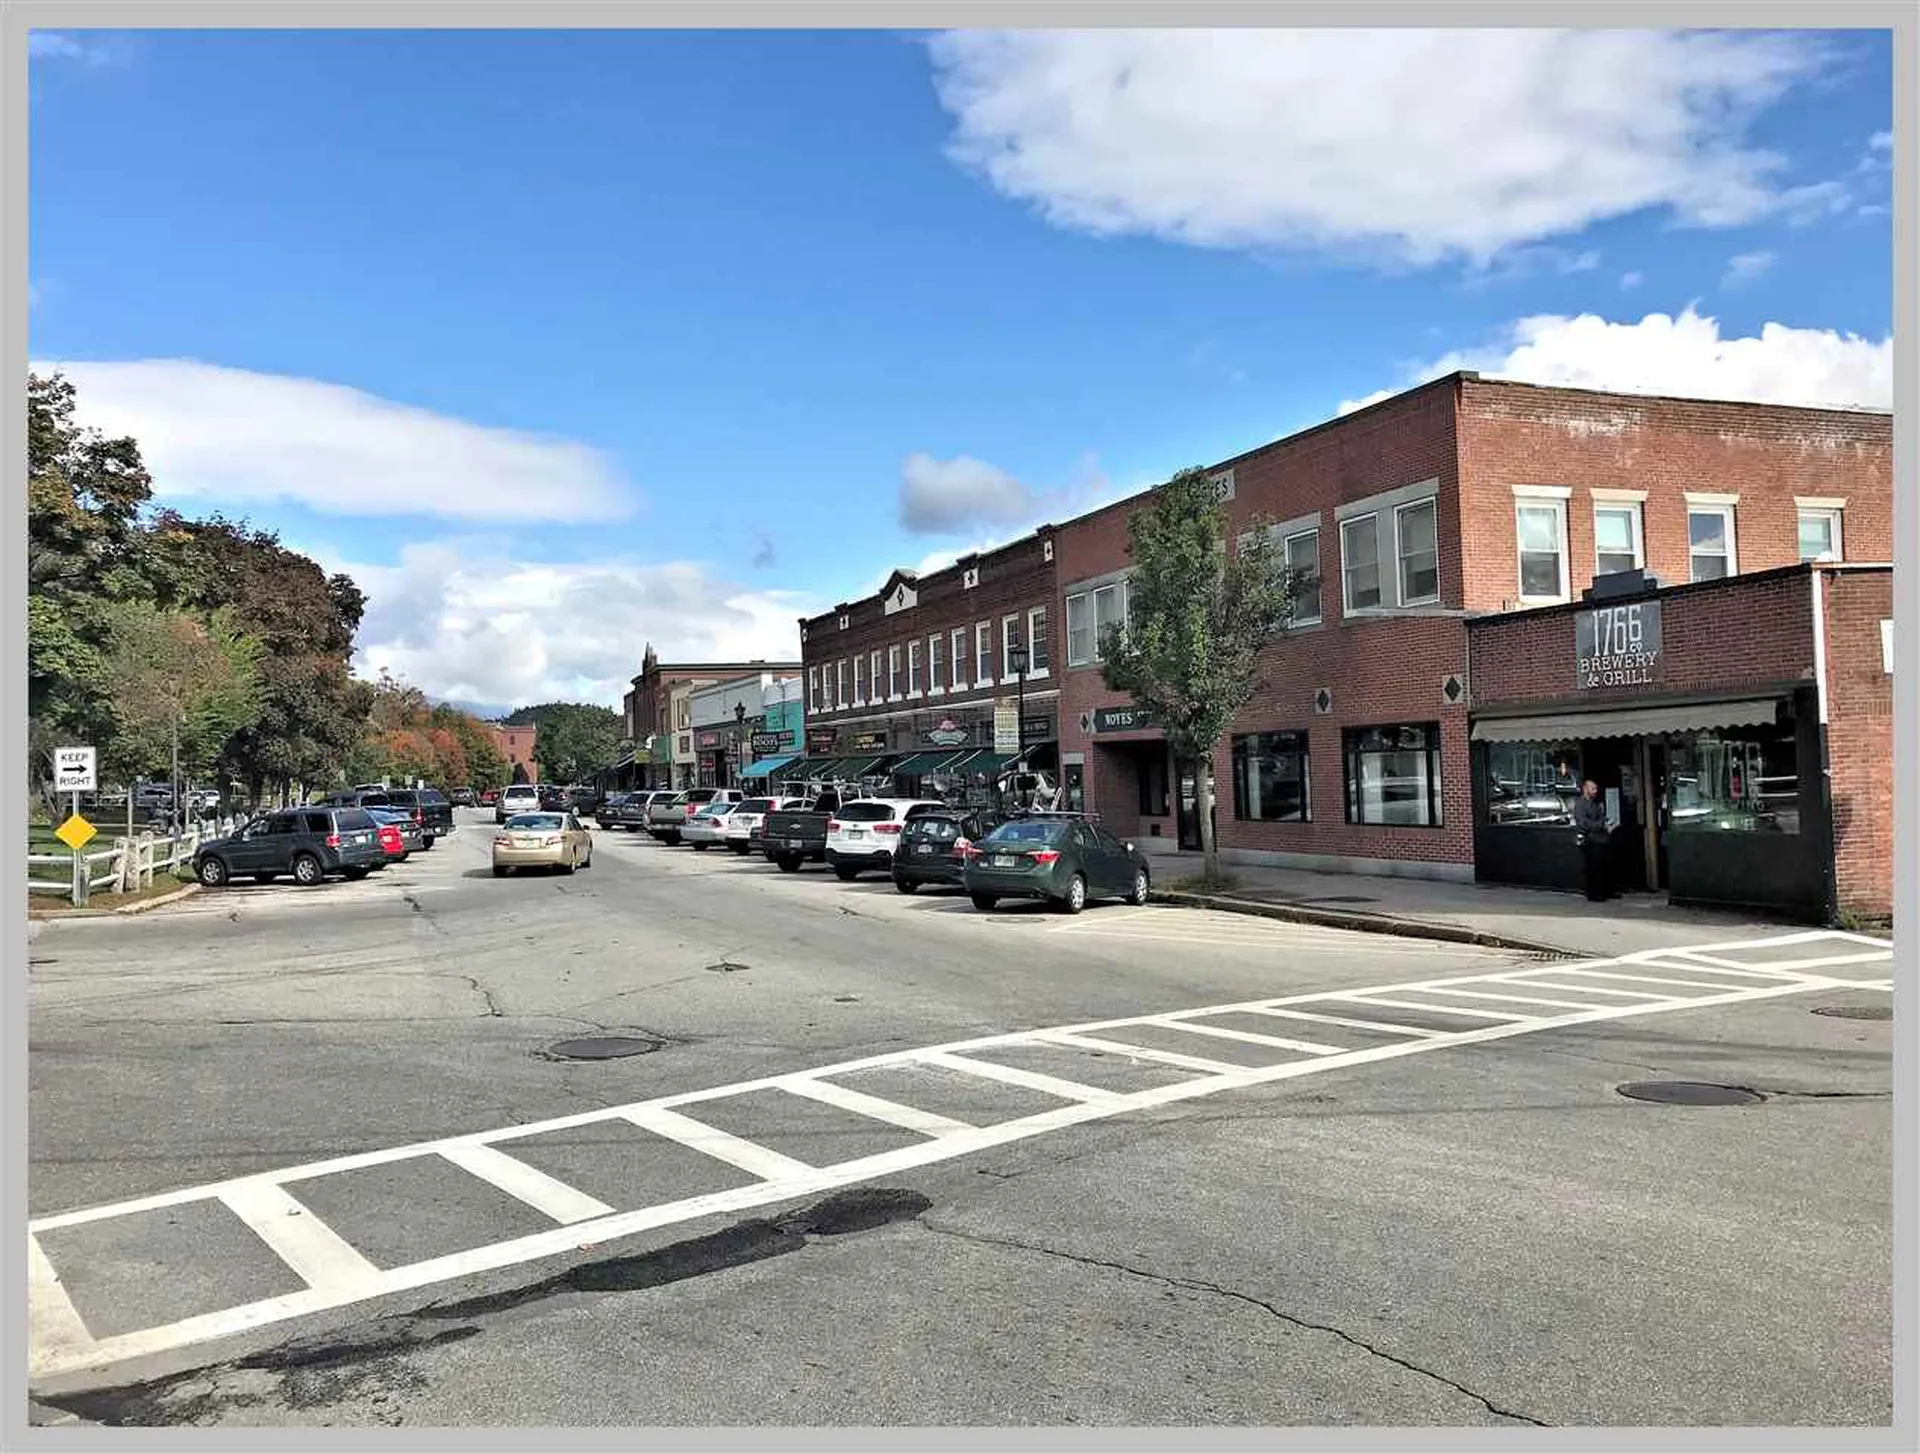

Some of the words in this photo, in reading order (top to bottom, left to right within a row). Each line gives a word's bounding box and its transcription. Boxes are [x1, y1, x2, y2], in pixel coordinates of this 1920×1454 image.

[1592, 604, 1642, 657] 1766
[1579, 651, 1657, 674] BREWERY
[1587, 672, 1600, 688] &
[1602, 668, 1653, 687] GRILL
[60, 752, 88, 762] KEEP
[59, 776, 91, 785] RIGHT
